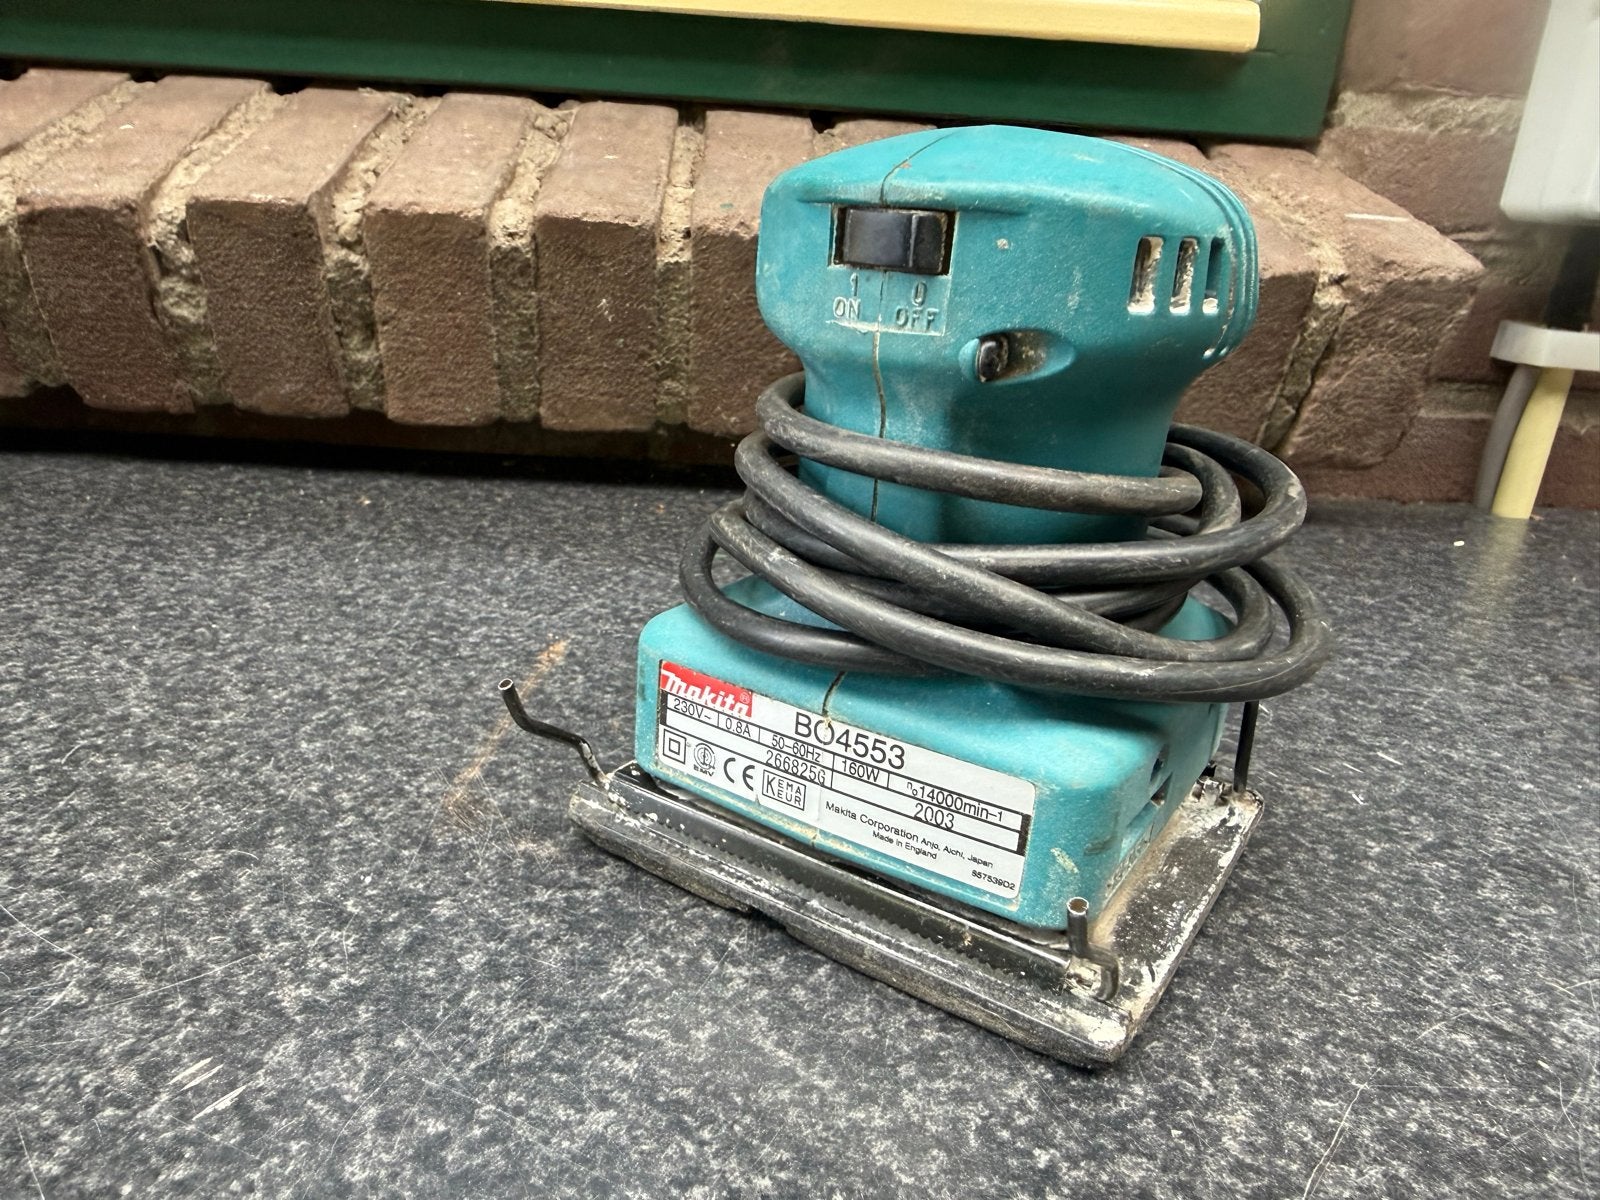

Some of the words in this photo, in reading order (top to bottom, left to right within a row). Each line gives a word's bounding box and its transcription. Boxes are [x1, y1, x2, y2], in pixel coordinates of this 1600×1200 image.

[833, 296, 861, 319] ON
[896, 306, 939, 330] OFF
[725, 717, 751, 738] 0.8A
[794, 711, 905, 769] BO4553
[771, 734, 822, 763] 50-60Hz
[765, 749, 826, 787] 266825G
[841, 760, 880, 783] 160W
[913, 802, 955, 830] 2003
[825, 801, 857, 820] Makita
[859, 814, 919, 843] Corporation
[921, 838, 941, 851] Anjo,
[943, 845, 965, 859] Aichi,
[967, 854, 994, 869] Japan
[872, 830, 894, 844] Made
[896, 838, 903, 848] in
[904, 842, 938, 859] England
